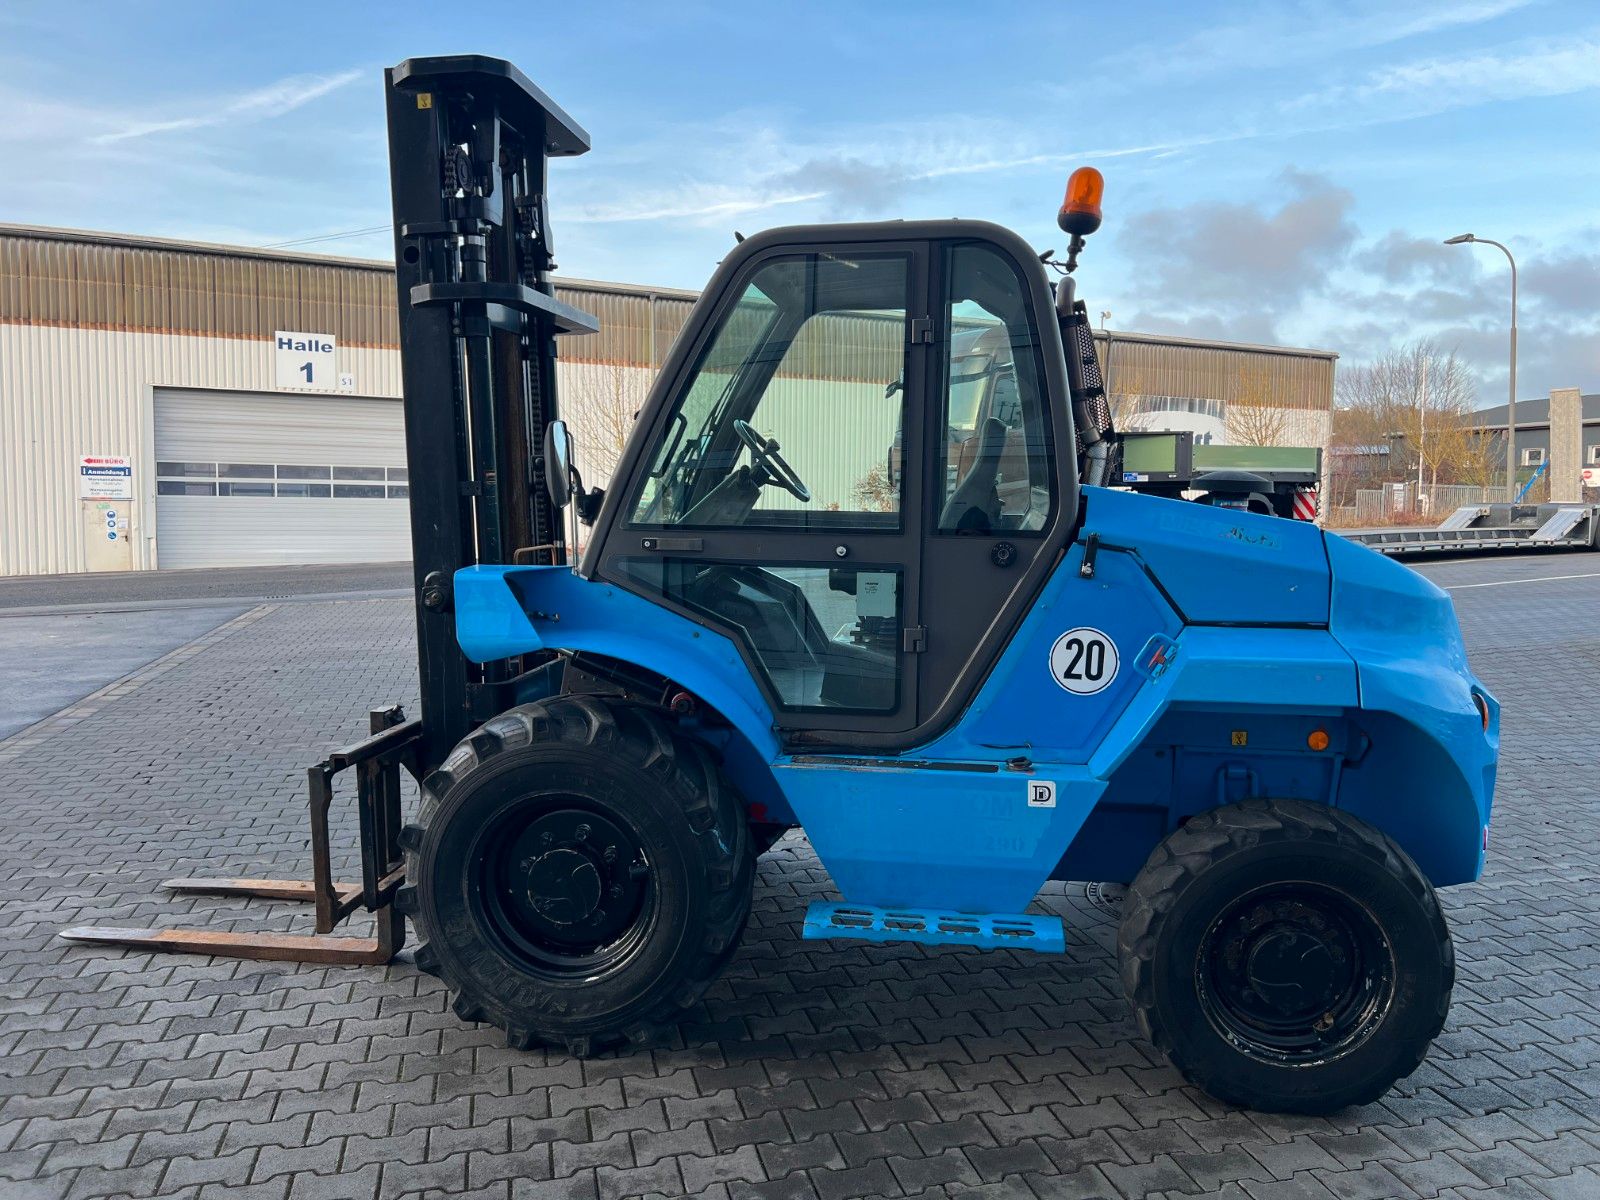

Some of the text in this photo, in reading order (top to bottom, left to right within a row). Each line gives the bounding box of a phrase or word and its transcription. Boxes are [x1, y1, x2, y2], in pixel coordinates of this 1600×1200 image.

[278, 337, 333, 353] Halle
[300, 361, 313, 383] 1
[1063, 638, 1106, 681] 20
